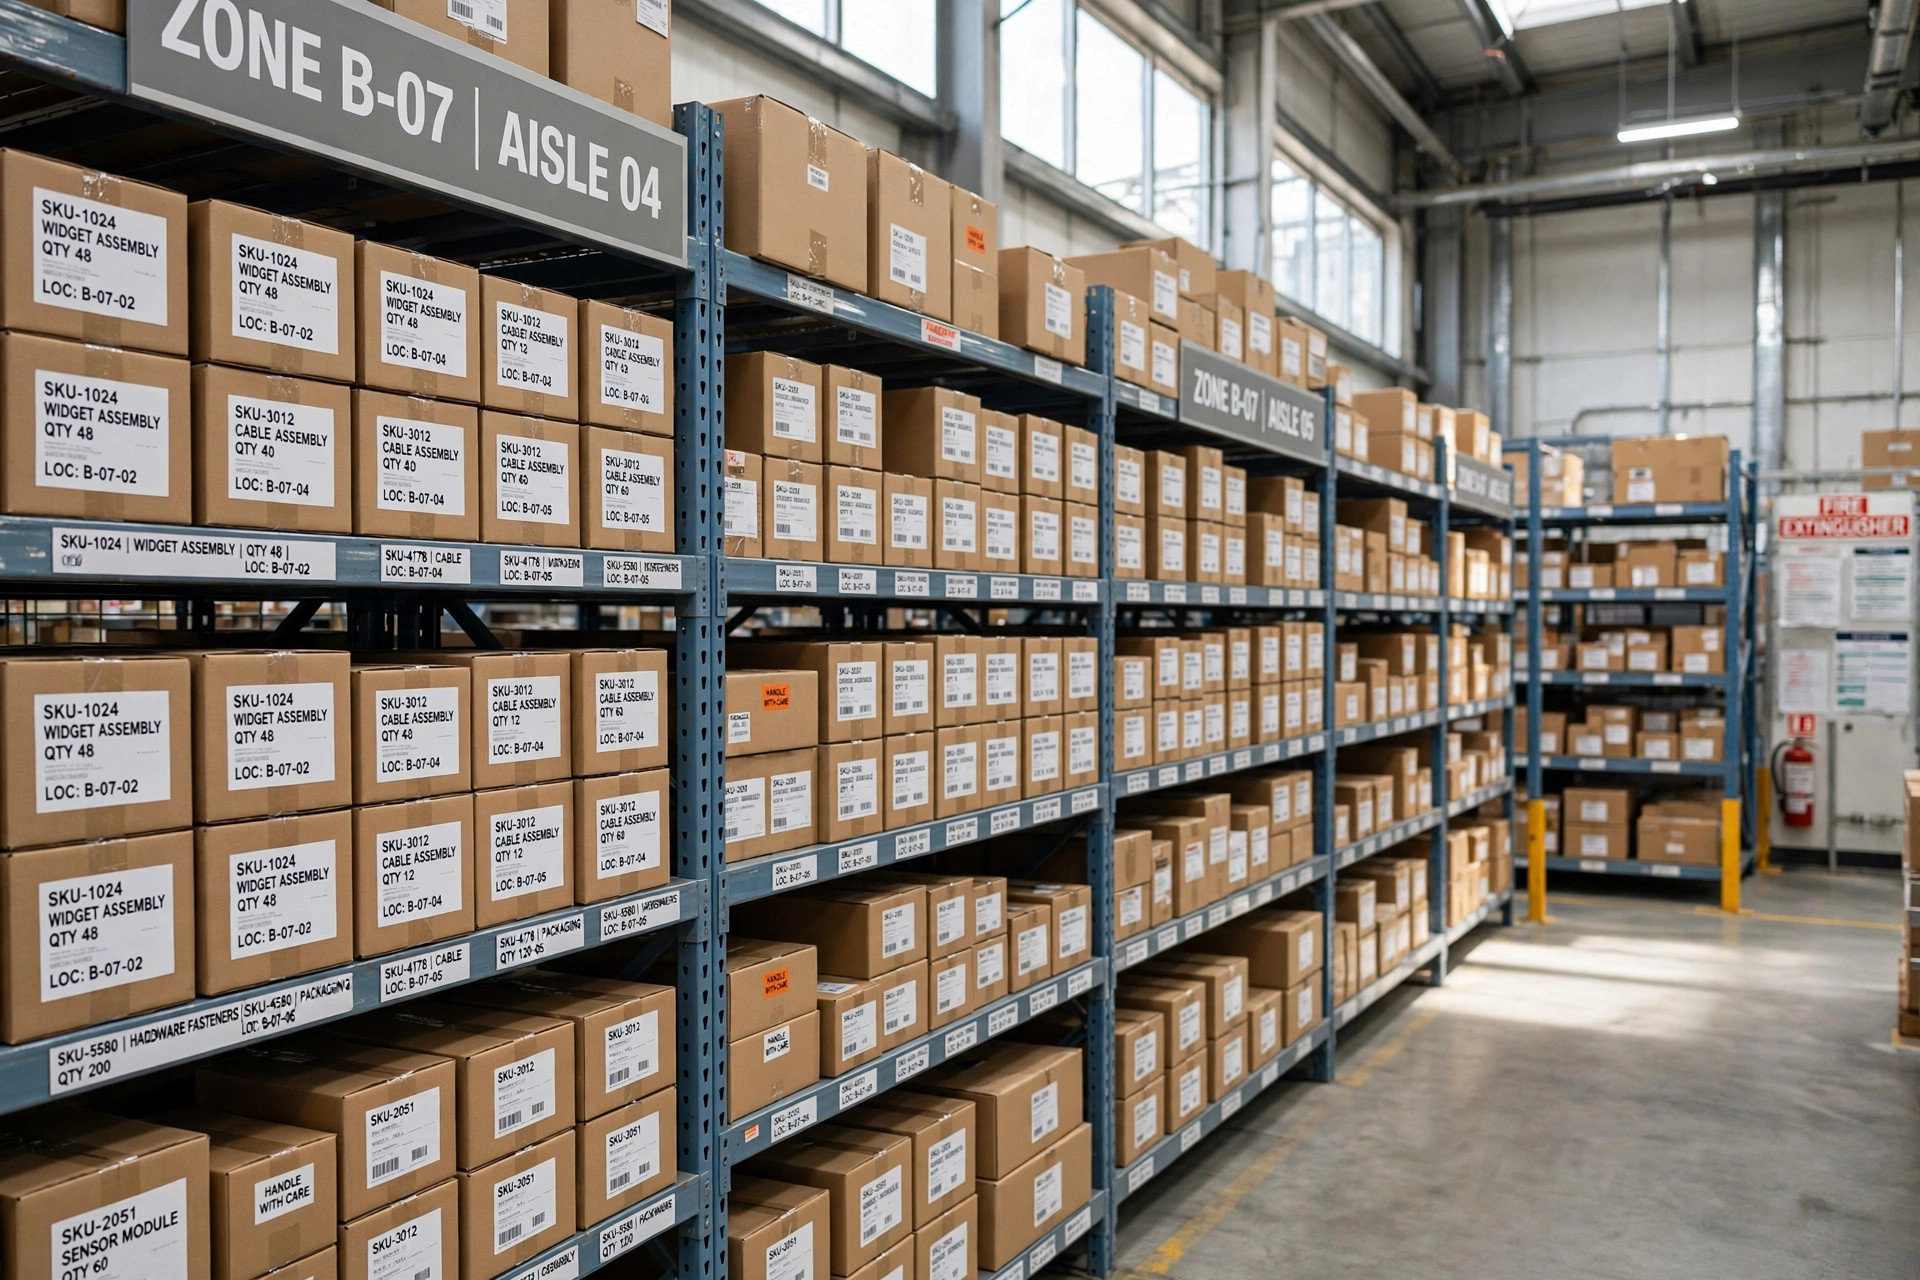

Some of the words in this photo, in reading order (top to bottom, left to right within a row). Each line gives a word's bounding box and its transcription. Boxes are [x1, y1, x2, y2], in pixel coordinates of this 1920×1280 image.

[161, 0, 322, 103] ZONE
[342, 46, 453, 144] B-07
[498, 110, 609, 202] AISLE
[620, 156, 662, 219] 04
[42, 199, 116, 230] SKU-1024
[41, 219, 92, 243] WIDGET
[96, 232, 158, 258] ASSEMBLY
[42, 240, 70, 258] QTY
[75, 247, 91, 263] 48
[238, 244, 297, 269] SKU-1024
[238, 261, 279, 282] WIDGET
[281, 272, 331, 294] ASSEMBLY
[42, 279, 76, 299] LOC:
[82, 286, 135, 310] B-07-02
[239, 280, 261, 296] QTY
[264, 286, 278, 300] 48
[386, 279, 433, 301] SKU-1024
[386, 296, 418, 313] WIDGET
[420, 304, 461, 323] ASSEMBLY
[239, 314, 266, 331] LOC:
[270, 320, 313, 341] B-07-02
[386, 311, 405, 325] QTY
[407, 317, 418, 329] 48
[386, 343, 408, 358] LOC:
[411, 347, 446, 365] B-07-04
[605, 359, 618, 371] QTY
[44, 381, 118, 404] SKU-1024
[44, 401, 94, 421] WIDGET
[98, 409, 160, 429] ASSEMBLY
[235, 404, 294, 426] SKU-3012
[1193, 368, 1229, 413] ZONE
[1231, 382, 1259, 422] B-07
[1268, 397, 1299, 437] AISLE
[1300, 408, 1314, 442] 05
[44, 421, 72, 438] QTY
[77, 426, 94, 441] 48
[235, 423, 271, 440] CABLE
[274, 429, 327, 447] ASSEMBLY
[382, 424, 431, 442] SKU-3012
[235, 441, 257, 455] QTY
[261, 444, 274, 458] 40
[382, 441, 412, 456] CABLE
[414, 445, 459, 461] ASSEMBLY
[501, 441, 541, 458] SKU-3012
[45, 461, 78, 478] LOC:
[83, 464, 137, 484] B-07-02
[383, 457, 401, 470] QTY
[235, 477, 262, 491] LOC:
[266, 479, 309, 496] B-07-04
[501, 471, 516, 483] QTY
[383, 489, 405, 502] LOC:
[408, 490, 444, 505] B-07-04
[1823, 497, 1861, 514] FIRE
[501, 501, 520, 512] LOC:
[522, 502, 552, 515] B-07-05
[61, 534, 121, 550] SKU-1024
[133, 538, 178, 553] WIDGET
[181, 541, 235, 555] ASSEMBLY
[246, 544, 267, 557] QTY
[270, 545, 282, 559] 48
[245, 561, 268, 573] LOC:
[271, 561, 310, 575] B-07-02
[435, 552, 462, 564] CABLE
[386, 565, 406, 577] LOC:
[409, 566, 442, 578] B-07-04
[233, 692, 293, 708] SKU-1024
[492, 684, 533, 697] SKU-3012
[44, 702, 119, 720] SKU-1024
[381, 696, 427, 710] SKU-3012
[492, 699, 518, 712] CABLE
[519, 698, 556, 710] ASSEMBLY
[233, 711, 274, 726] WIDGET
[276, 709, 327, 724] ASSEMBLY
[381, 712, 410, 726] CABLE
[411, 710, 454, 724] ASSEMBLY
[492, 715, 508, 727] QTY
[511, 714, 520, 725] 12
[43, 723, 95, 740] WIDGET
[98, 720, 161, 736] ASSEMBLY
[234, 730, 257, 744] QTY
[260, 729, 274, 742] 48
[381, 729, 399, 742] QTY
[44, 744, 73, 760] QTY
[77, 743, 94, 757] 48
[493, 743, 512, 756] LOC:
[514, 741, 544, 754] B-07-04
[235, 765, 262, 780] LOC:
[266, 761, 309, 777] B-07-02
[382, 760, 403, 773] LOC:
[406, 757, 440, 771] B-07-04
[45, 784, 79, 801] LOC:
[84, 779, 138, 797] B-07-02
[600, 800, 636, 816] SKU-3012
[495, 816, 535, 833] SKU-3012
[382, 834, 429, 853] SKU-3012
[495, 833, 520, 848] CABLE
[522, 827, 559, 842] ASSEMBLY
[237, 854, 296, 876] SKU-1024
[382, 853, 411, 869] CABLE
[414, 846, 456, 863] ASSEMBLY
[495, 849, 511, 863] QTY
[513, 847, 523, 859] 12
[236, 875, 277, 894] WIDGET
[279, 867, 329, 887] ASSEMBLY
[382, 871, 401, 885] QTY
[404, 869, 414, 881] 12
[496, 878, 514, 892] LOC:
[517, 871, 546, 888] B-07-05
[48, 881, 122, 907] SKU-1024
[237, 895, 259, 912] QTY
[262, 893, 276, 907] 48
[48, 905, 99, 927] WIDGET
[102, 894, 165, 918] ASSEMBLY
[383, 902, 405, 917] LOC:
[407, 895, 442, 912] B-07-04
[49, 929, 77, 947] QTY
[81, 926, 98, 941] 48
[238, 931, 265, 948] LOC:
[268, 921, 311, 942] B-07-02
[435, 949, 462, 966] CABLE
[50, 969, 84, 988] LOC:
[89, 956, 143, 980] B-07-02
[385, 980, 406, 995] LOC:
[408, 969, 442, 989] B-07-05
[58, 1039, 118, 1066] SKU-5580
[188, 1007, 239, 1032] FASTENERS
[608, 1021, 640, 1041] SKU-3012
[58, 1066, 84, 1085] QTY
[88, 1059, 111, 1078] 200
[370, 1102, 414, 1126] SKU-2051
[264, 1174, 301, 1197] HANDLE
[259, 1196, 283, 1214] WITH
[285, 1185, 310, 1204] CARE
[62, 1206, 135, 1245] SKU-2051
[62, 1232, 118, 1266] SENSOR
[122, 1210, 178, 1243] MODULE
[372, 1225, 417, 1255] SKU-3012
[62, 1263, 89, 1280] QTY
[92, 1256, 108, 1273] 60
